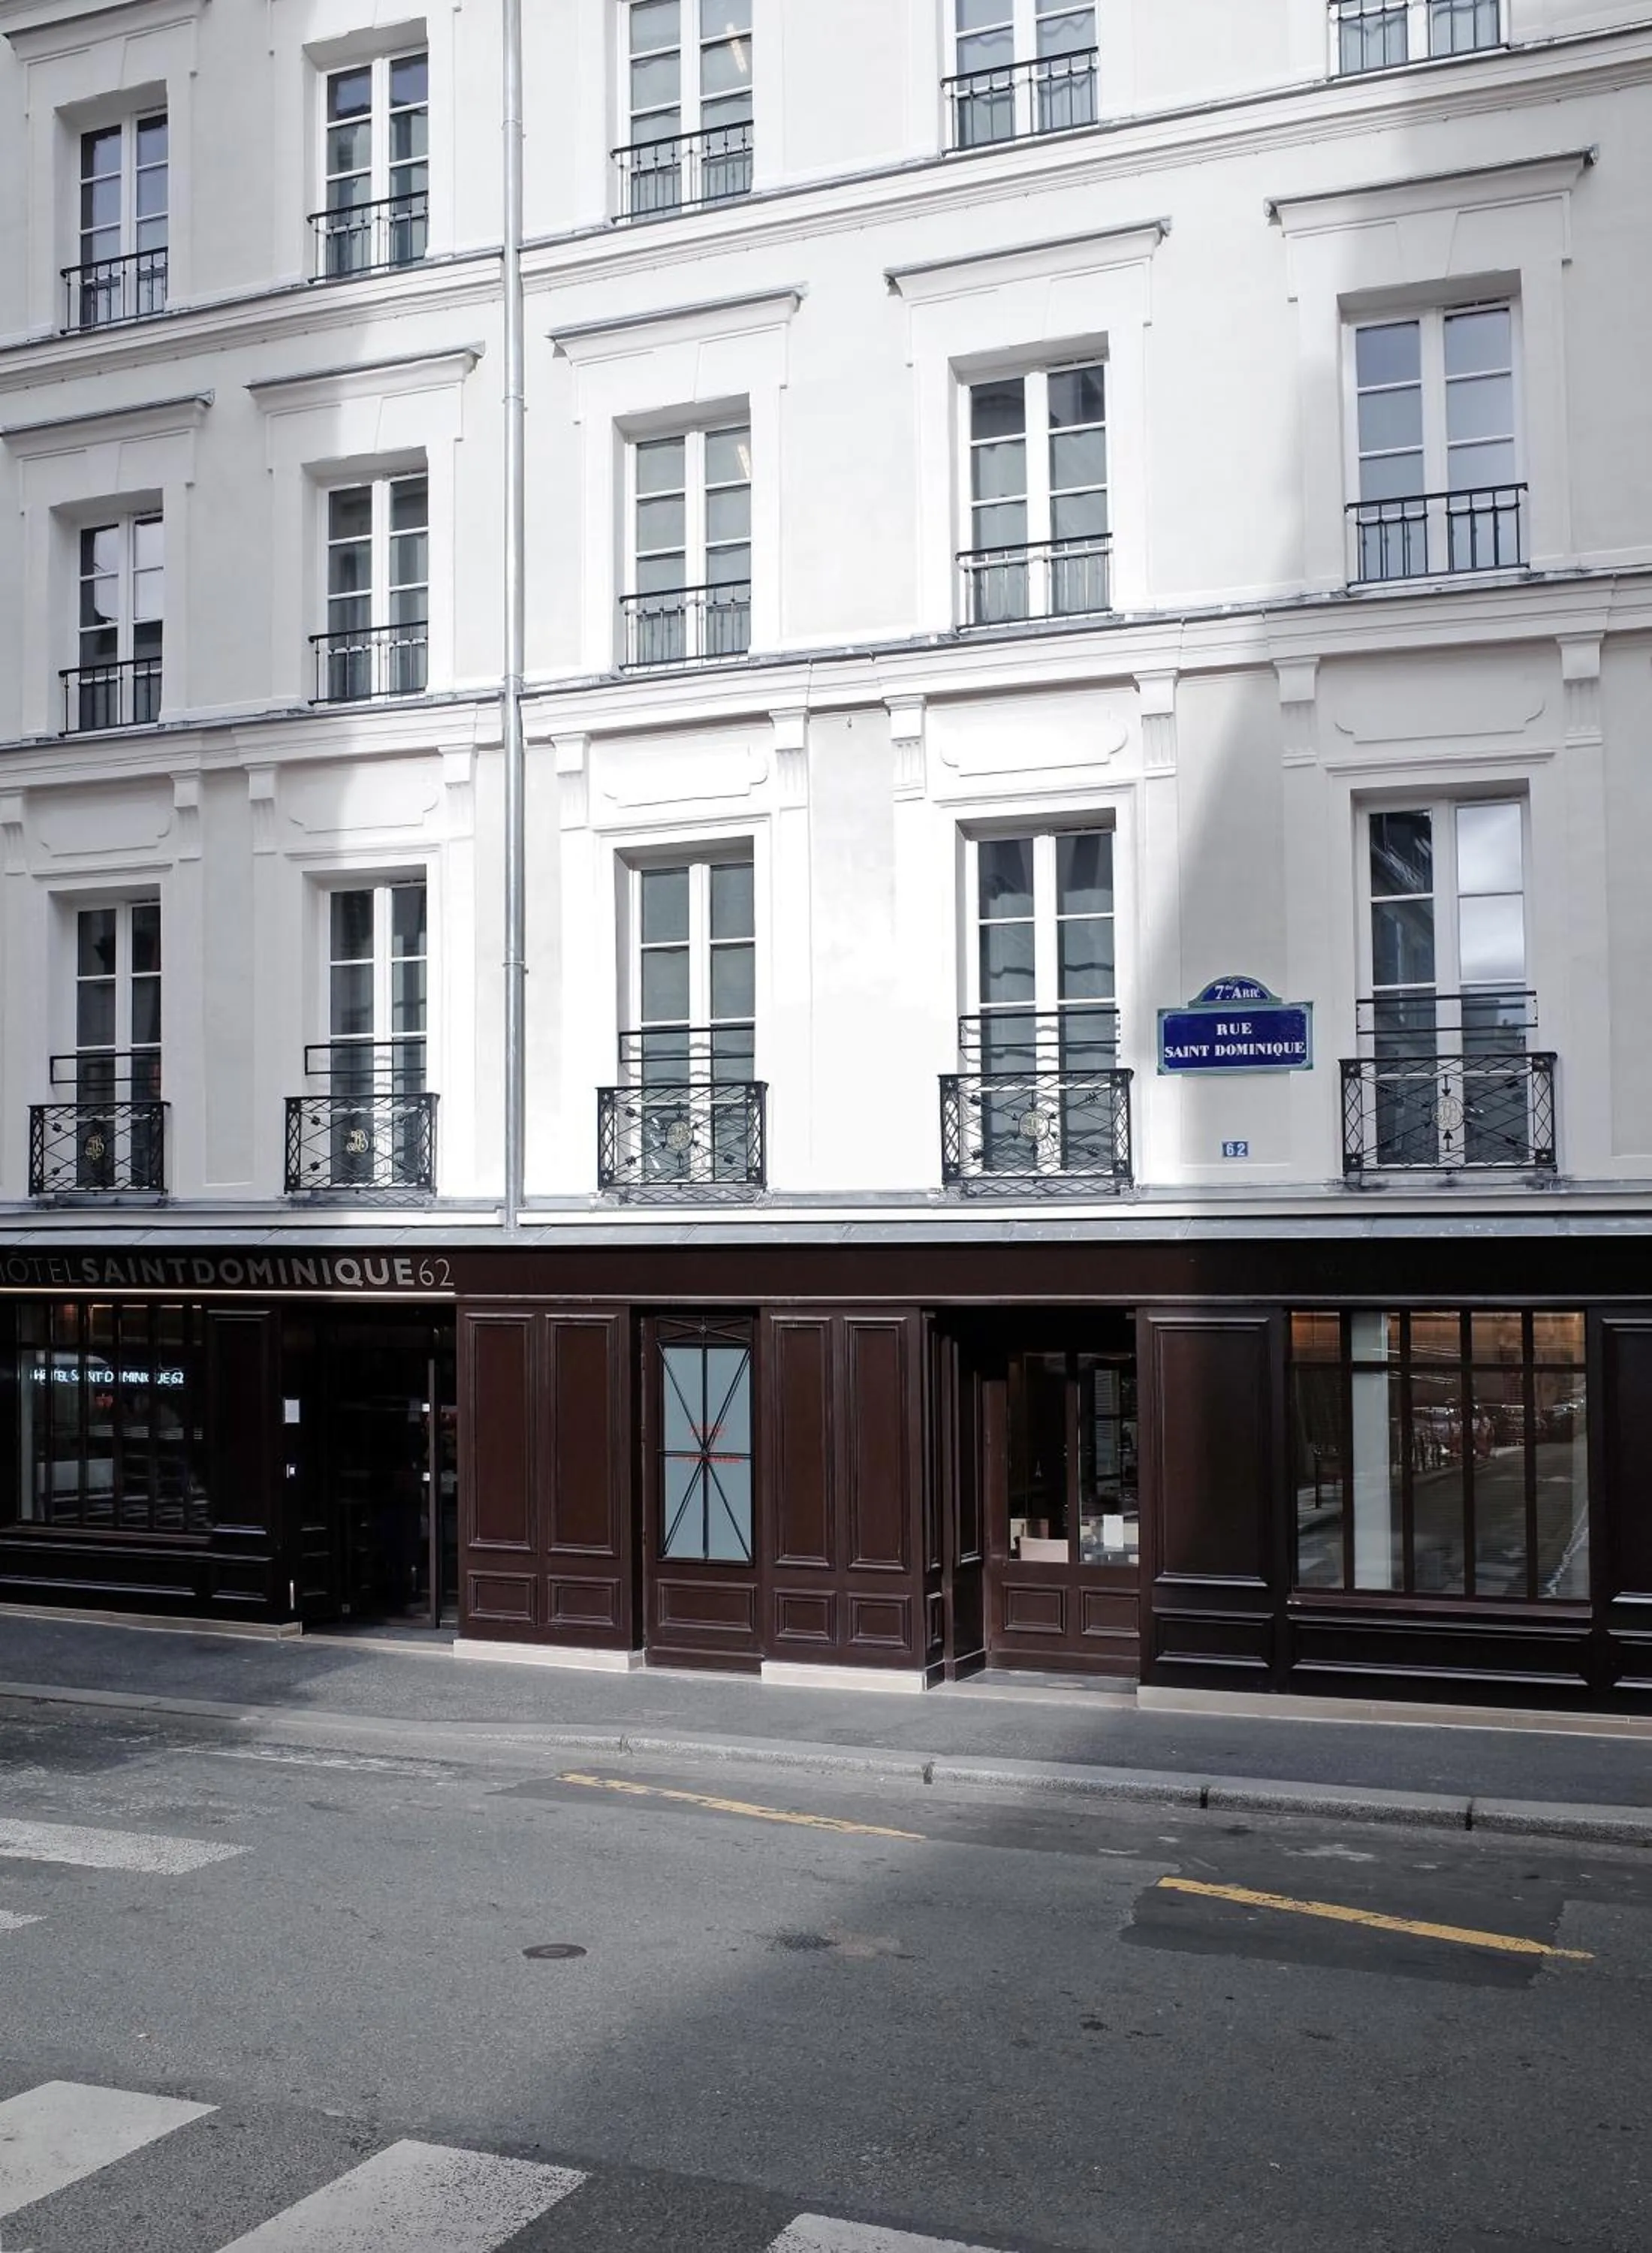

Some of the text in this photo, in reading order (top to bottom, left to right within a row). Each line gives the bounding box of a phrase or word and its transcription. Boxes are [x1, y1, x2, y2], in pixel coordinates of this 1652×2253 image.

[1216, 1022, 1253, 1036] RUE
[1165, 1042, 1306, 1058] SAINT DOMINIQUE
[1225, 1142, 1246, 1157] 62
